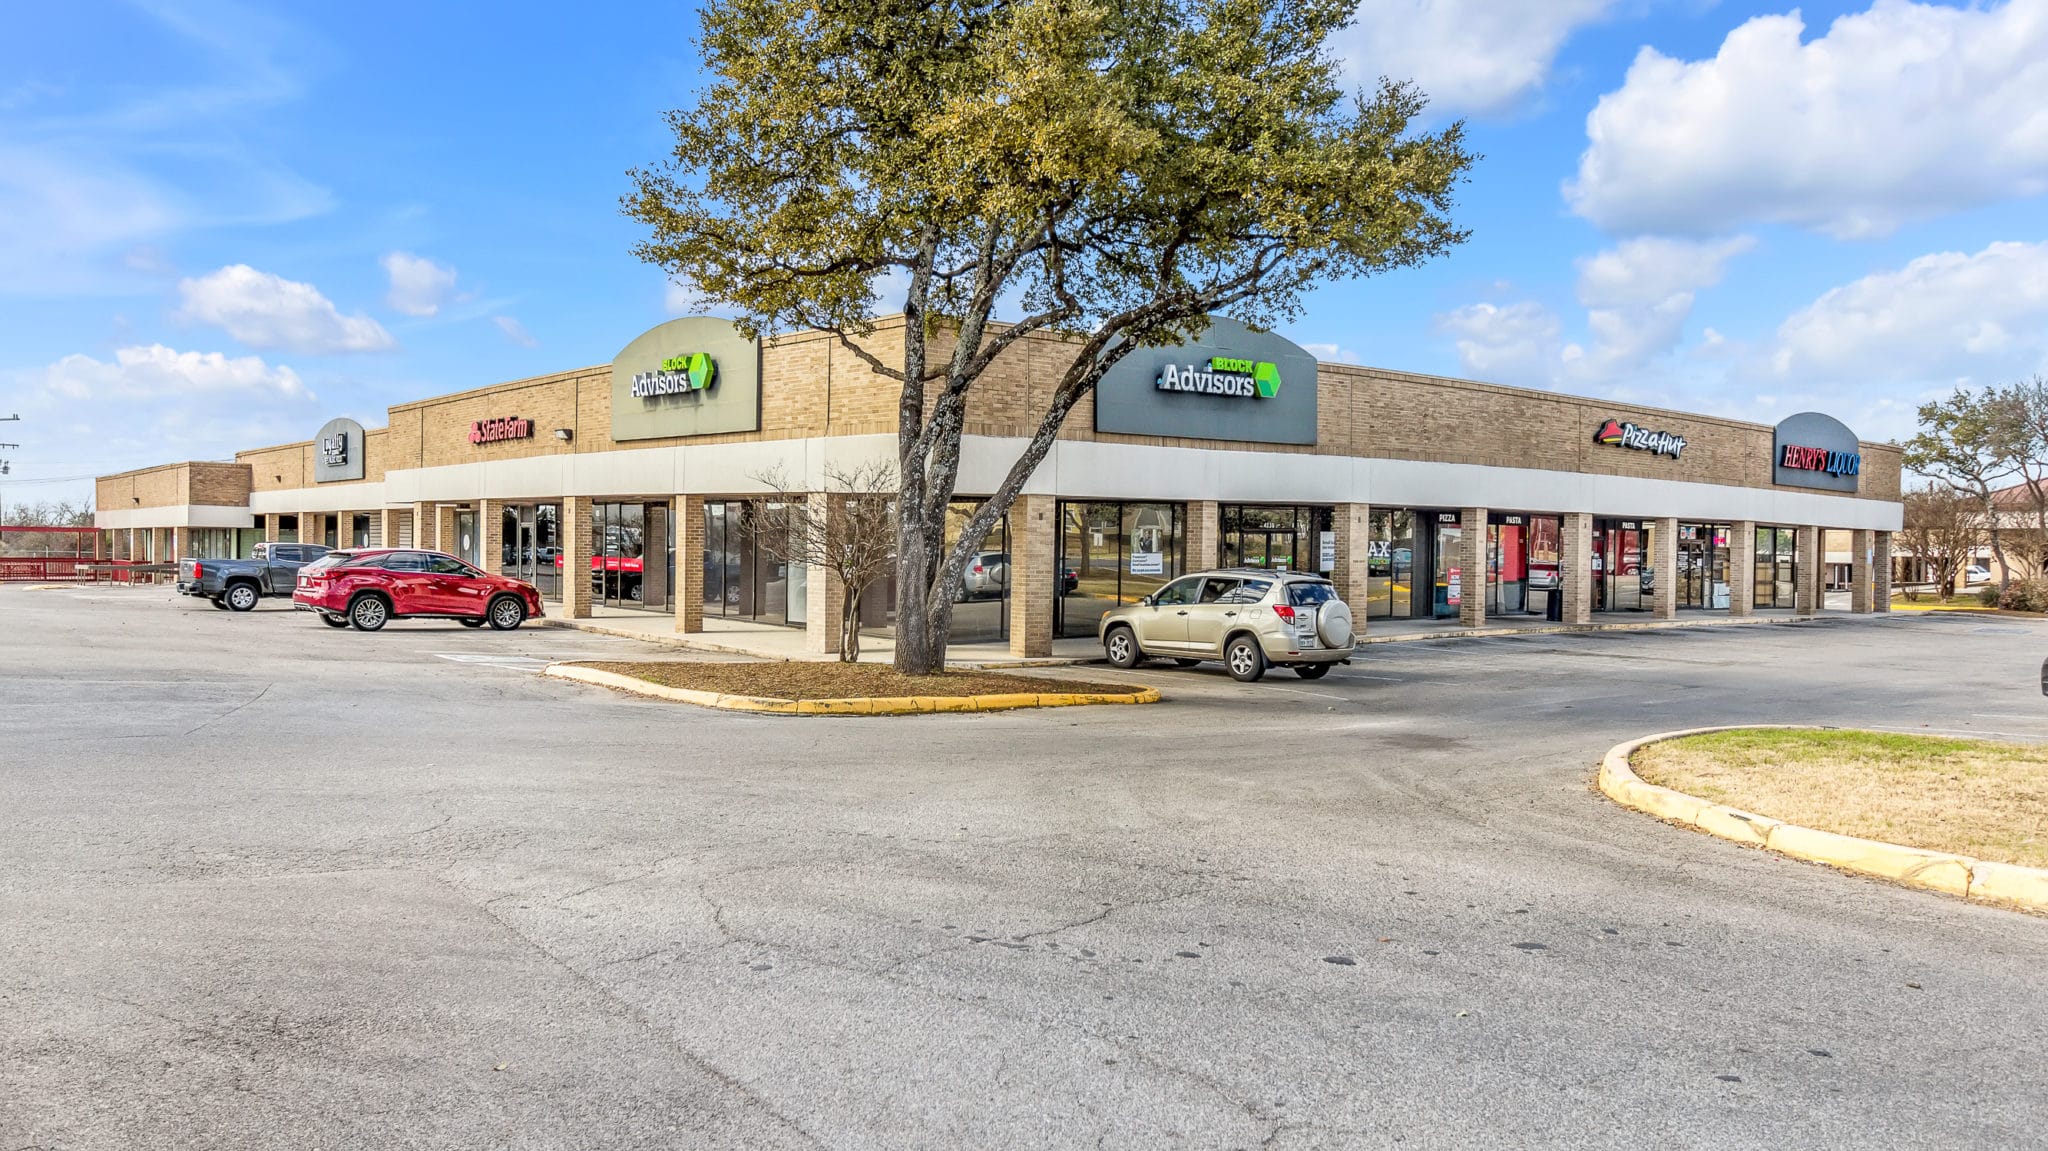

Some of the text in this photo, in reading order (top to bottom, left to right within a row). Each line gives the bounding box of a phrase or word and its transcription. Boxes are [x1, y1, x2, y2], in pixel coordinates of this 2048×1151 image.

[661, 356, 688, 371] BLOCK
[1213, 357, 1254, 373] BLOCK
[631, 370, 688, 398] Advisors
[1160, 363, 1255, 397] Advisors
[1621, 423, 1658, 450] Pizza
[1783, 445, 1827, 471] HENRY'S
[1438, 514, 1456, 523] PIZZA
[1505, 516, 1522, 525] PASTA
[1621, 521, 1636, 530] PASTA
